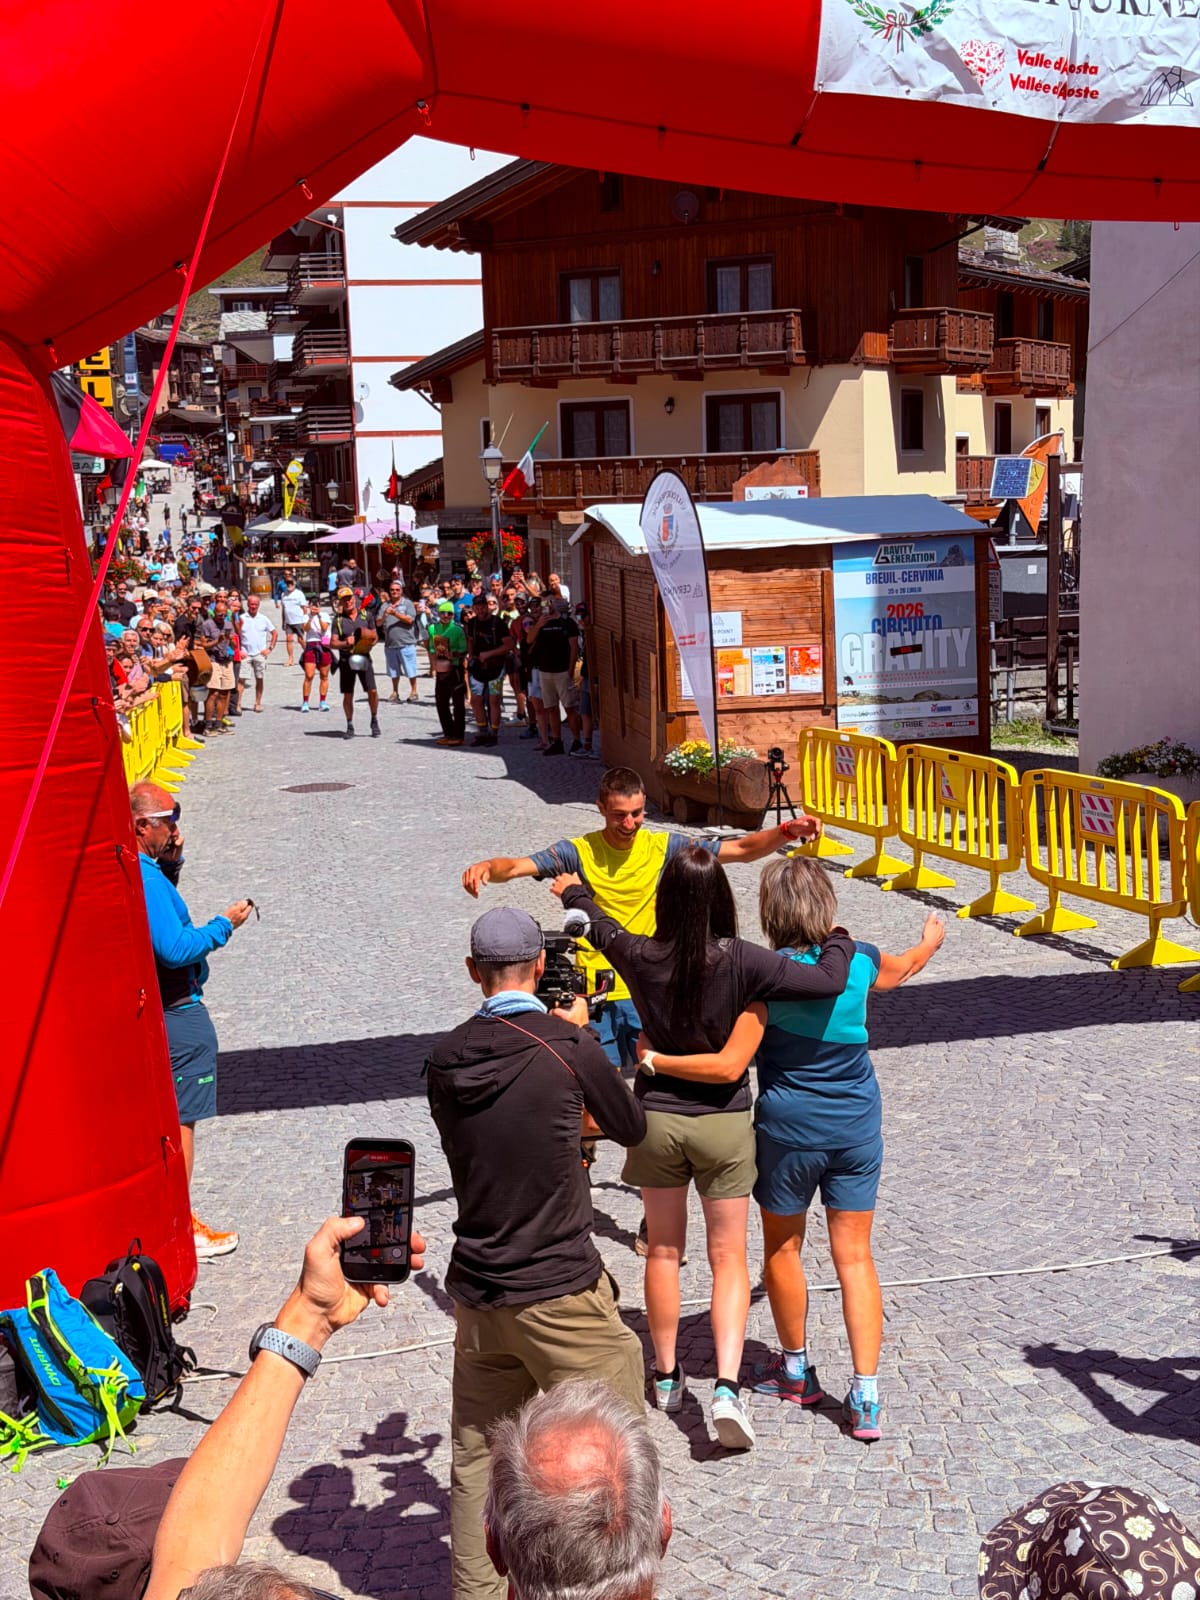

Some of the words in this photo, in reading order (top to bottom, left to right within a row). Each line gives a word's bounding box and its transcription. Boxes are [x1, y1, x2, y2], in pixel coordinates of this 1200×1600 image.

[1017, 49, 1052, 69] Valle
[1053, 56, 1099, 76] dAosta
[1009, 73, 1051, 93] Vallée
[865, 569, 944, 585] BREUIL-CERVINIA
[886, 602, 924, 619] 2026
[871, 615, 943, 637] CIRCUITO
[841, 627, 971, 674] GRAVITY
[901, 720, 924, 728] TRIBE
